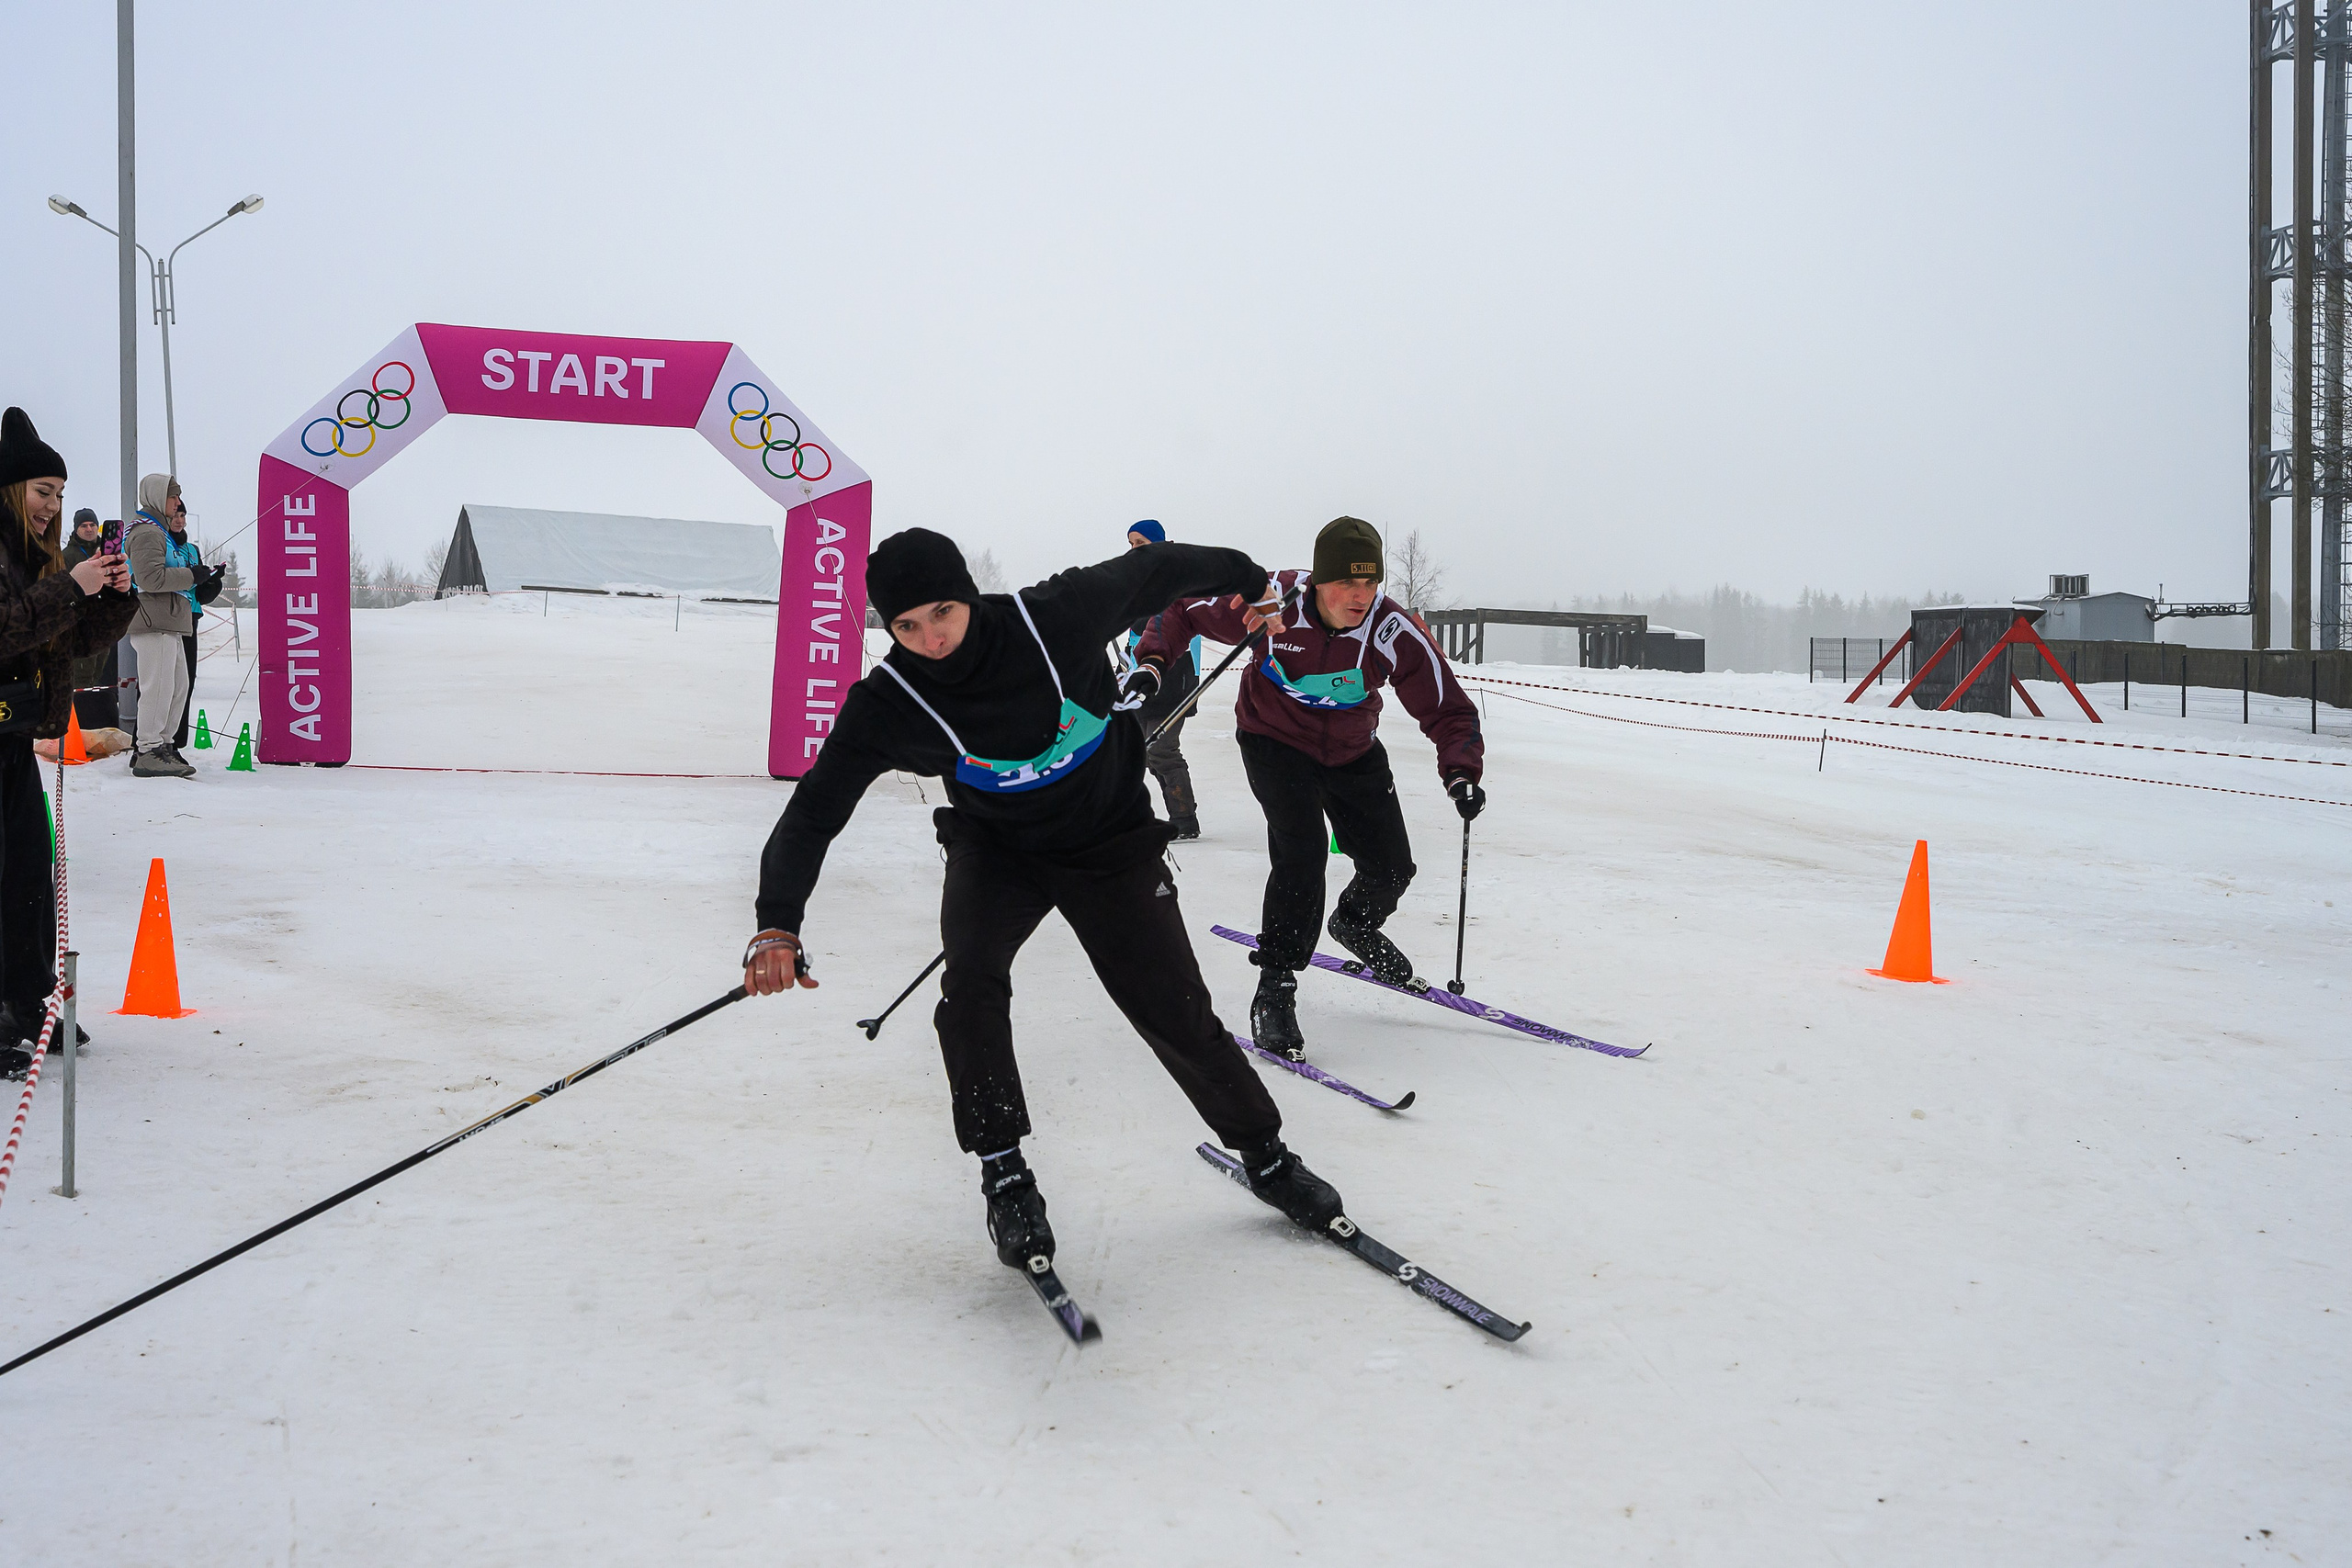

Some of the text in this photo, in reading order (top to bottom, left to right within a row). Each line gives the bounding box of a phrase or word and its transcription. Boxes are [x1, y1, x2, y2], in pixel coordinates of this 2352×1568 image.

[481, 348, 665, 400] START
[284, 494, 322, 741] ACTIVE LIFE
[804, 518, 847, 758] ACTIVE LIFE
